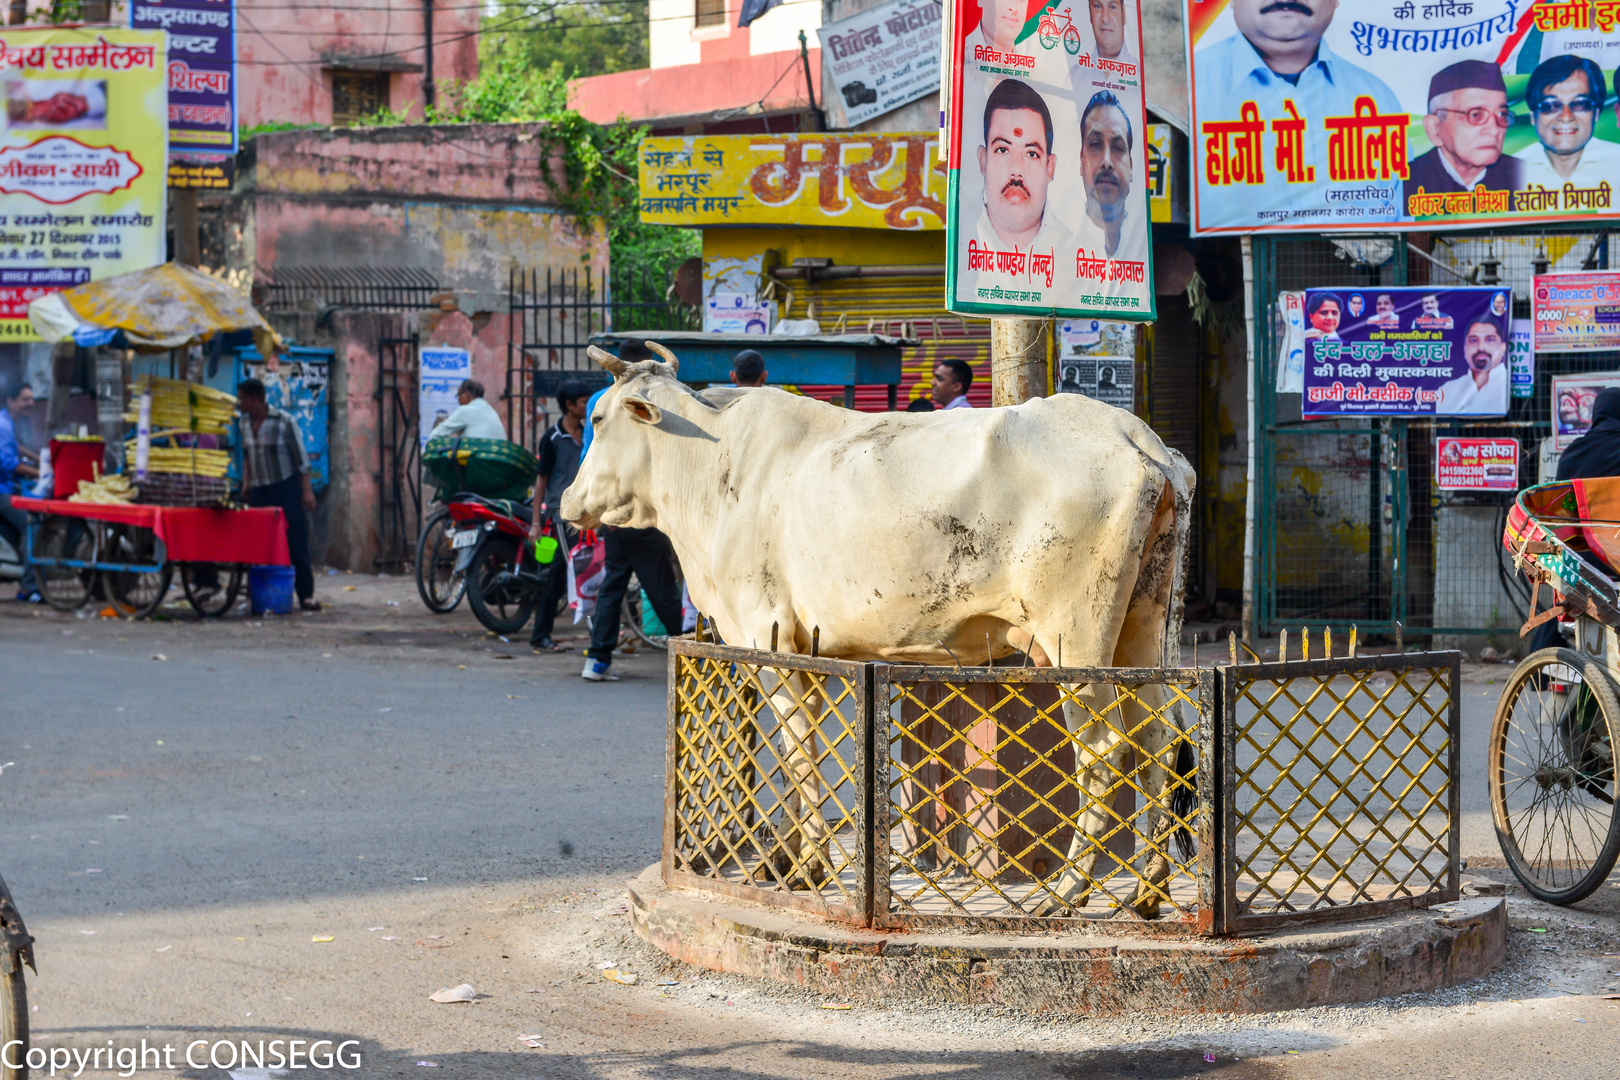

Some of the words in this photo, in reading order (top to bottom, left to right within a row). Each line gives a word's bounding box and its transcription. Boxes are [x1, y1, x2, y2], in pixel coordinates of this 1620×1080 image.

[1393, 4, 1415, 20] की
[51, 37, 156, 69] सम्मेलन
[168, 34, 219, 54] न्टर
[974, 44, 1002, 63] नितिन
[1078, 53, 1095, 69] मो.
[168, 61, 230, 92] शिल्पा
[1202, 101, 1265, 186] हाजी
[1272, 99, 1315, 184] मो.
[1324, 95, 1411, 182] तालिब
[702, 144, 725, 169] से
[71, 158, 119, 178] साथी
[656, 173, 713, 194] भरपूर
[1324, 185, 1396, 204] (महासचिव)
[1409, 186, 1444, 215] शंकर
[1475, 184, 1509, 213] मिश्रा
[1514, 183, 1559, 212] संतोष
[1563, 180, 1611, 210] त्रिपाठी
[640, 192, 700, 217] वनस्पति
[702, 196, 744, 218] मयूर
[1257, 210, 1290, 222] कानपुर
[1292, 208, 1332, 219] महानगर
[1368, 204, 1396, 216] कमेटी
[14, 211, 85, 227] सम्मेलन
[91, 212, 153, 227] समारोह
[967, 239, 995, 273] विनोद
[996, 244, 1027, 277] पाण्डेय
[1076, 247, 1107, 285] जितेन्द्र
[1108, 259, 1145, 286] अग्रवाल
[1549, 286, 1593, 301] Doeacc
[1313, 363, 1334, 378] की
[1375, 366, 1454, 382] मुबारकबाद
[1308, 381, 1344, 402] हाजी
[1480, 440, 1516, 458] सोफा
